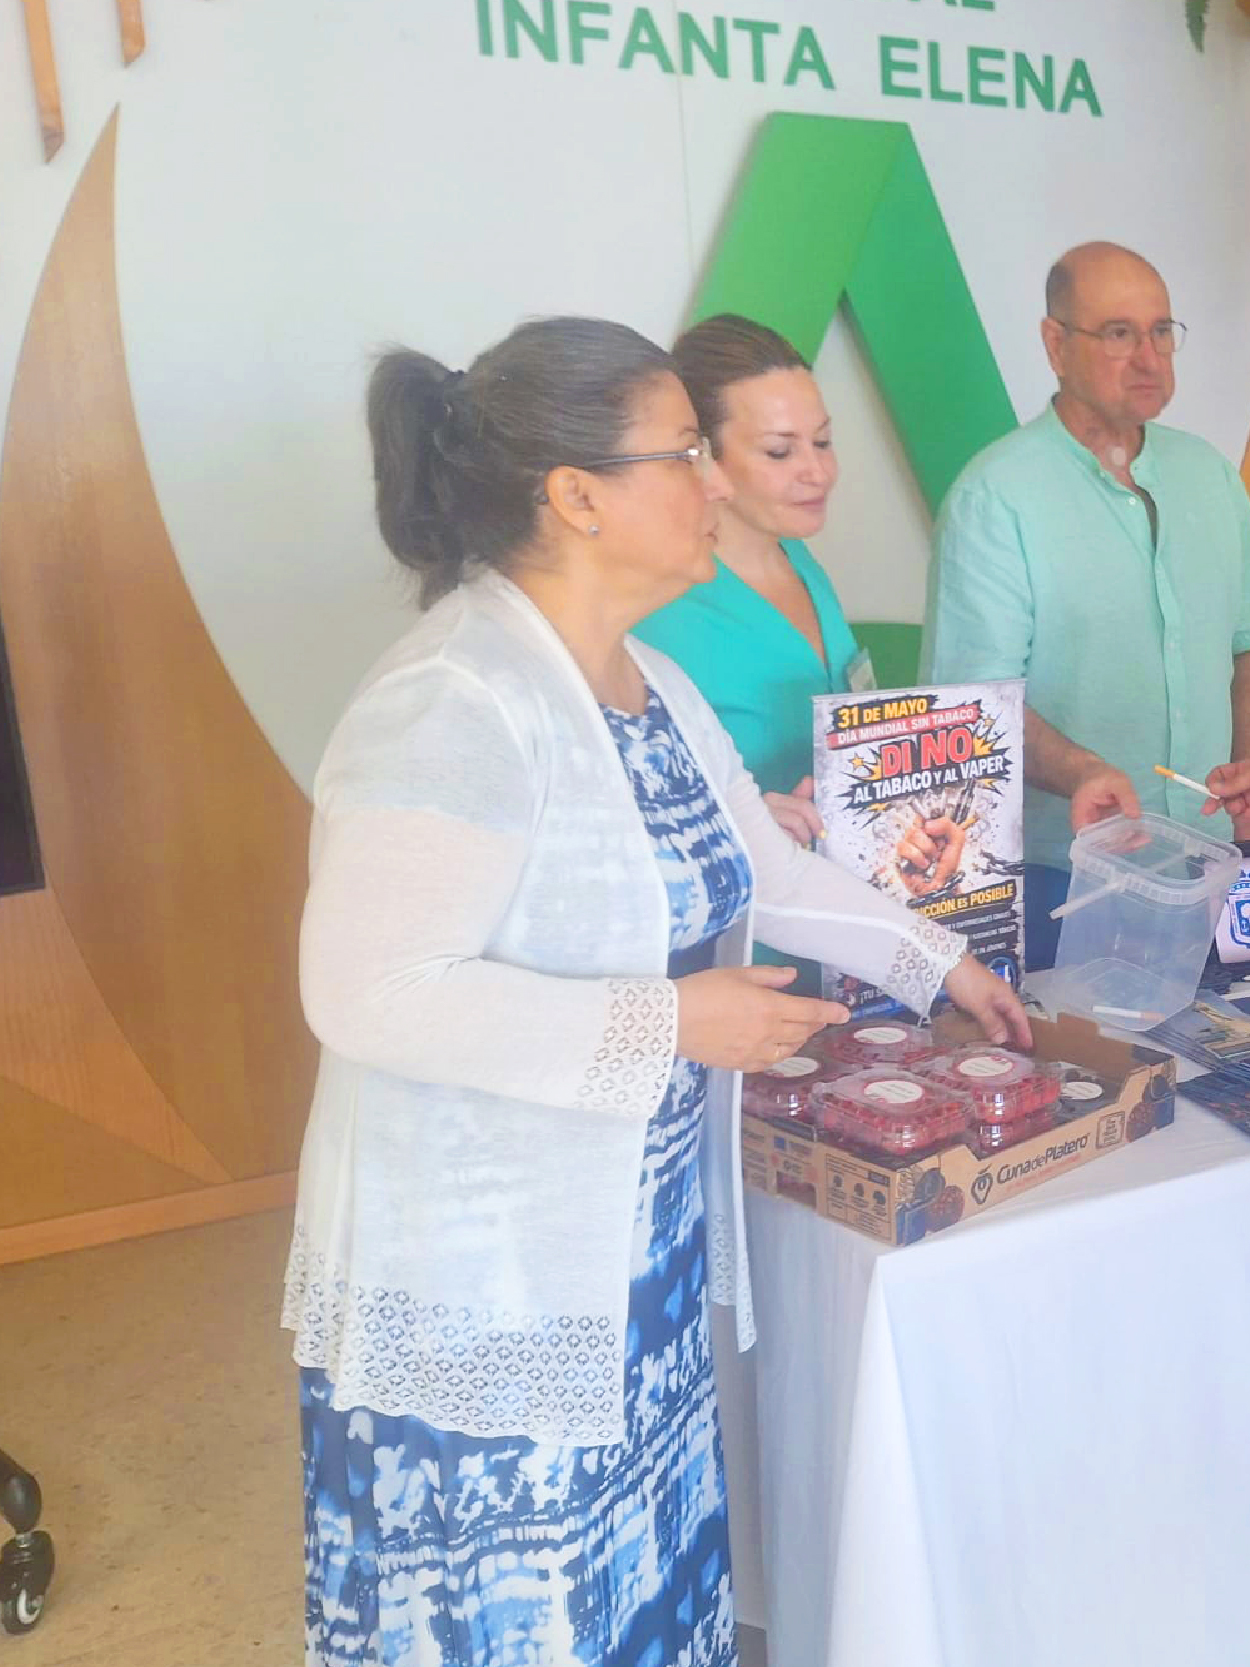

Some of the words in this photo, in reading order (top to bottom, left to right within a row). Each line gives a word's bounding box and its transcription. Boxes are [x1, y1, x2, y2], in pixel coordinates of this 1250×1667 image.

[475, 0, 836, 91] INFANTA
[877, 33, 1104, 118] ELENA
[837, 707, 859, 729] 31
[863, 708, 882, 724] DE
[884, 698, 929, 720] MAYO
[858, 722, 909, 742] MUNDIAL
[911, 716, 930, 731] SIN
[931, 708, 975, 726] TABACO
[881, 741, 914, 779] DI
[920, 727, 973, 770] NO
[853, 786, 873, 804] AL
[872, 769, 933, 801] TABACO
[932, 770, 942, 784] Y
[944, 768, 959, 783] AL
[959, 755, 1005, 780] VAPER
[970, 882, 1014, 907] POSIBLE
